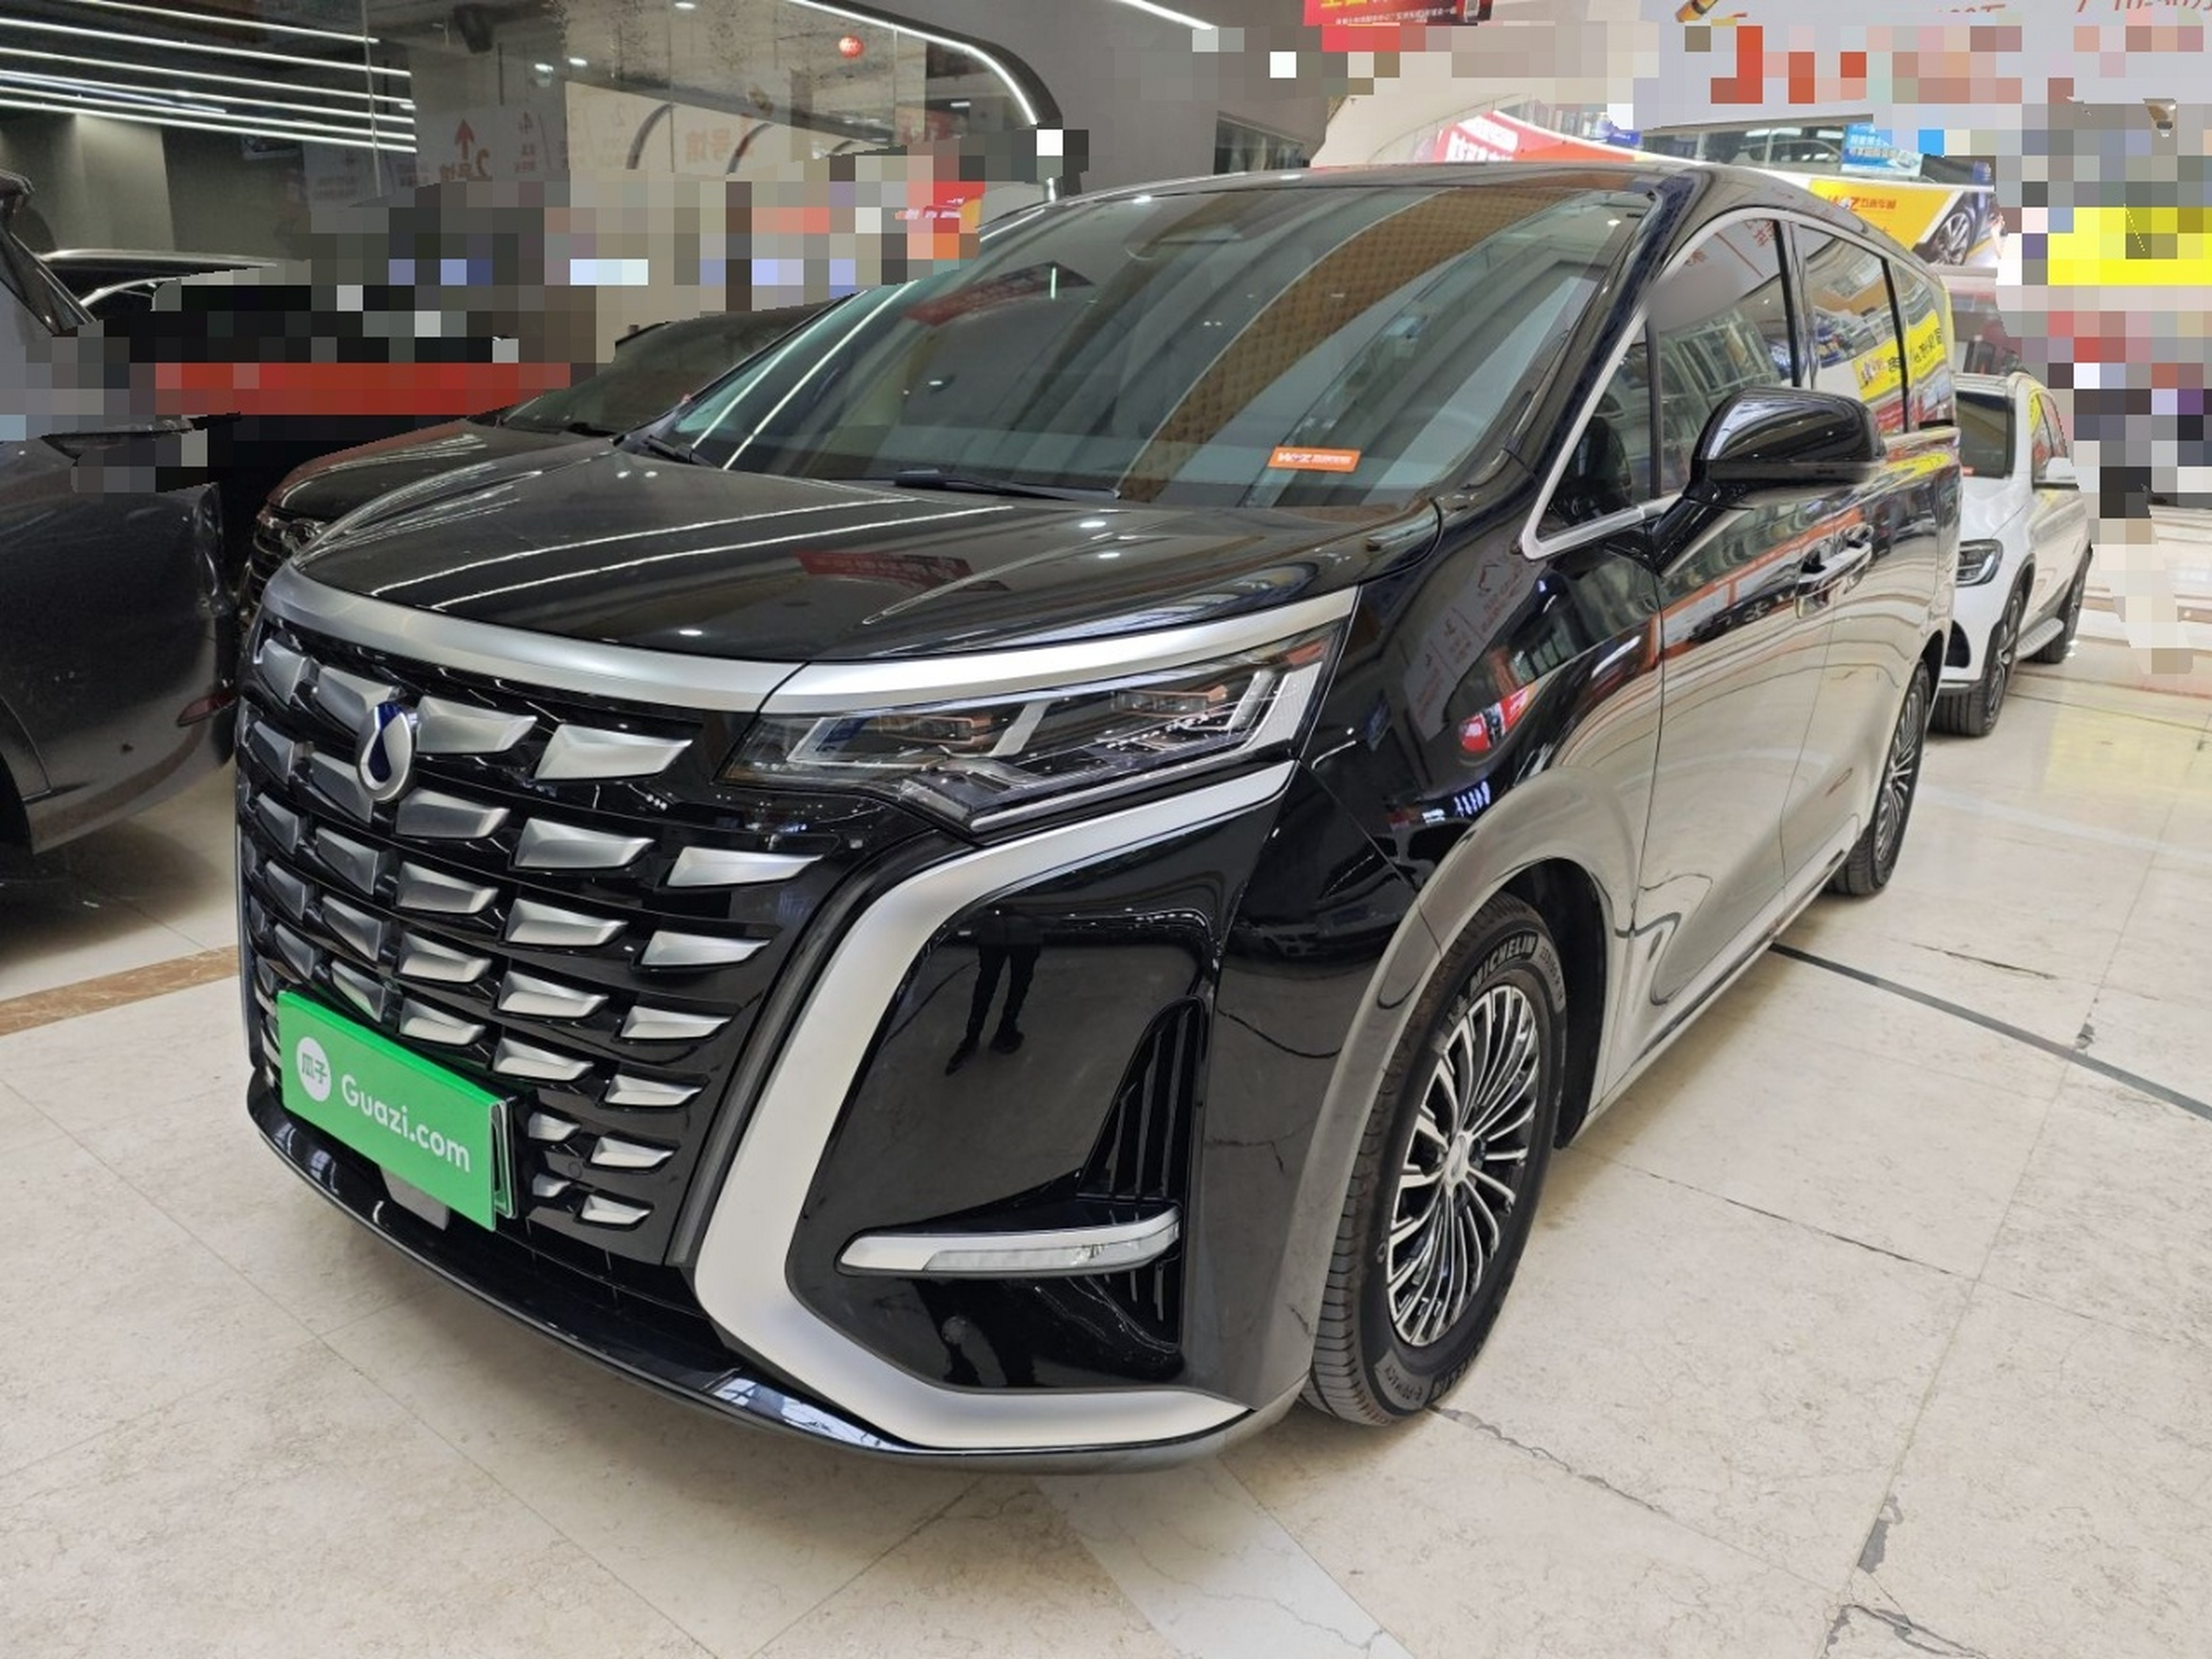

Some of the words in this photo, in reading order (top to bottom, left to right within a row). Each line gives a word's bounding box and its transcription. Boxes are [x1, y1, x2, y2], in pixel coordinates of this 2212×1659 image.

[1469, 934, 1537, 998] MICHELIN
[302, 1052, 328, 1084] 瓜子
[342, 1074, 469, 1172] Guazi.com
